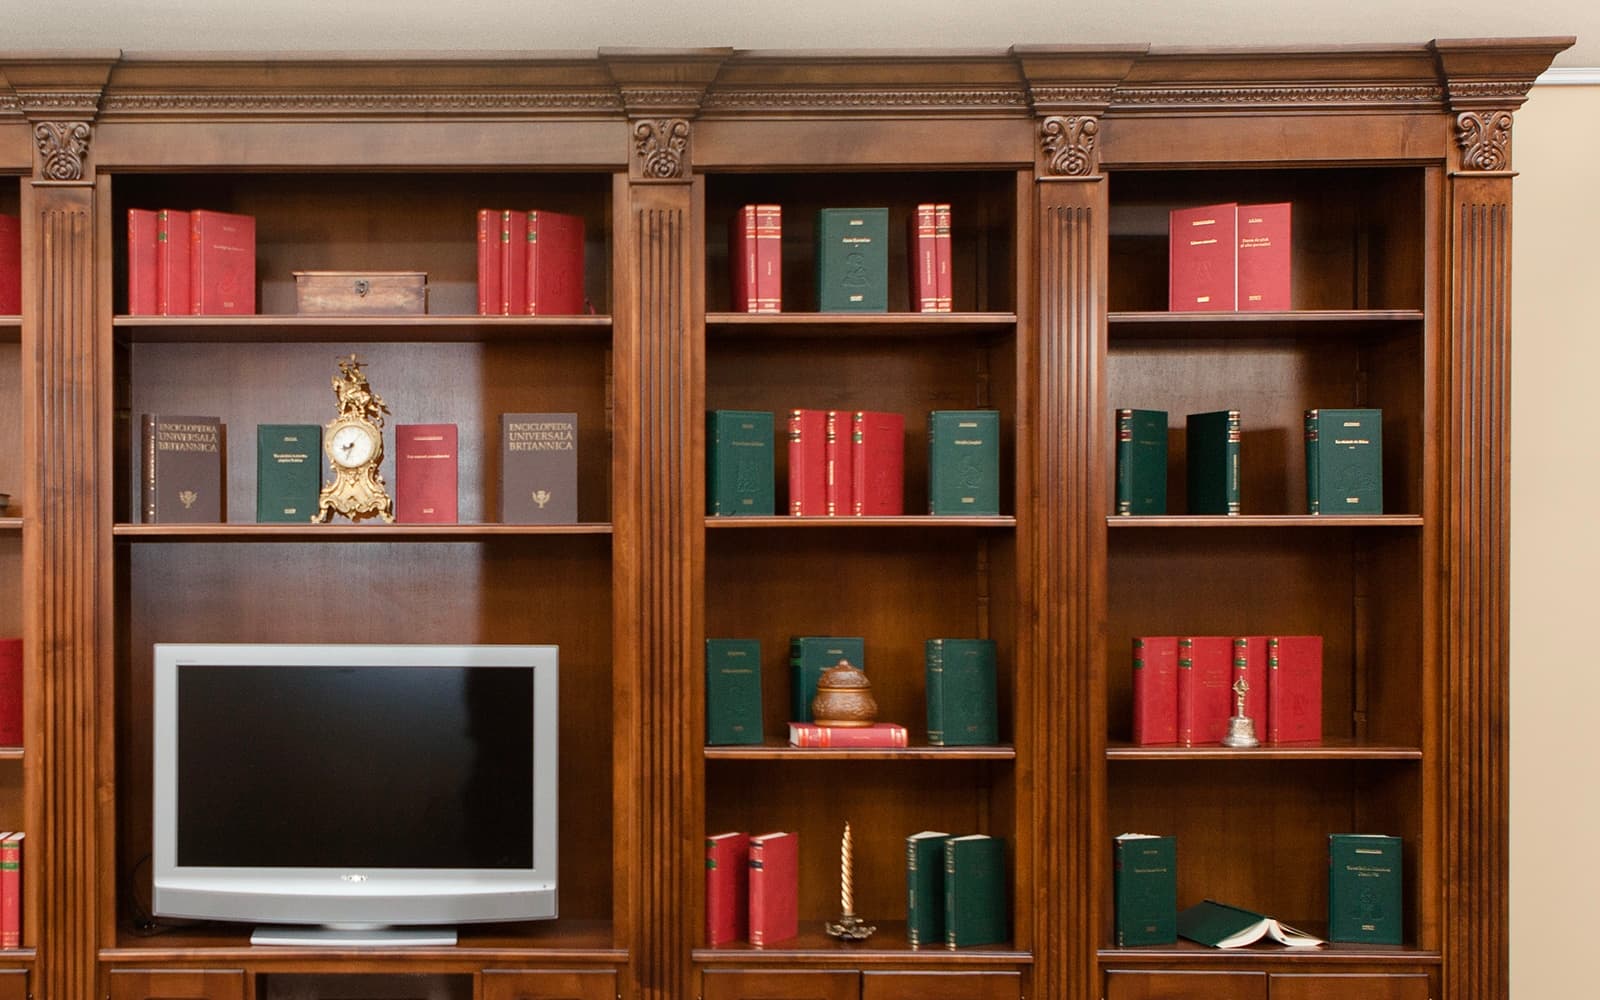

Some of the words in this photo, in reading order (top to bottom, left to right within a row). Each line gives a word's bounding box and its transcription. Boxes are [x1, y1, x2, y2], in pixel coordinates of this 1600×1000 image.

[159, 423, 216, 433] ENCICLOPEDIA
[509, 423, 573, 431] ENCICLOPEDIA
[158, 441, 217, 452] BRITANNICA
[509, 441, 573, 451] BRITANNICA
